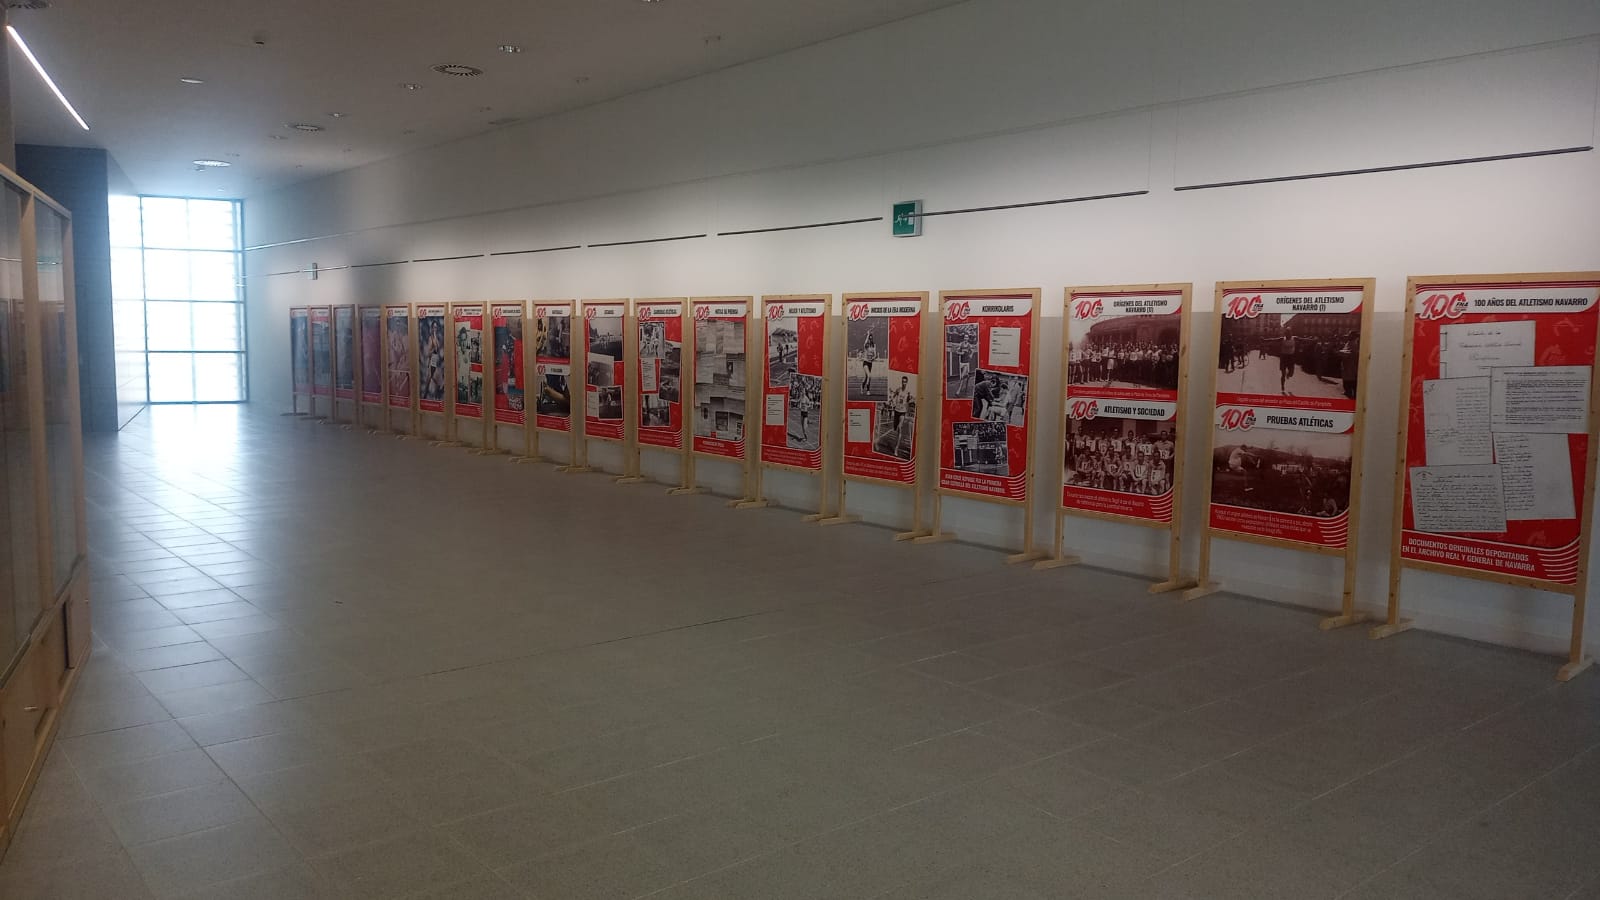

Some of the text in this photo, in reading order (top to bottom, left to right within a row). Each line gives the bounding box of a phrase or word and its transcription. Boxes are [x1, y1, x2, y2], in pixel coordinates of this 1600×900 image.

[1276, 296, 1302, 304] ORÍGENES
[1487, 297, 1505, 306] AÑOS
[1506, 298, 1517, 306] DEL
[1518, 298, 1553, 306] ATLETISMO
[1555, 298, 1588, 306] NAVARRO
[1104, 406, 1132, 414] ATLETISMO
[1138, 408, 1165, 416] SOCIEDAD
[1266, 416, 1334, 428] PRUEBAS ATLÉTICAS
[1408, 538, 1529, 562] DOCUMENTOS ORIGINALES DEPOSITADOS
[1418, 548, 1444, 558] ARCHIVO
[1446, 552, 1460, 560] REAL
[1466, 555, 1494, 566] GENERAL
[1495, 559, 1504, 567] DE
[1504, 560, 1536, 572] NAVARRA
